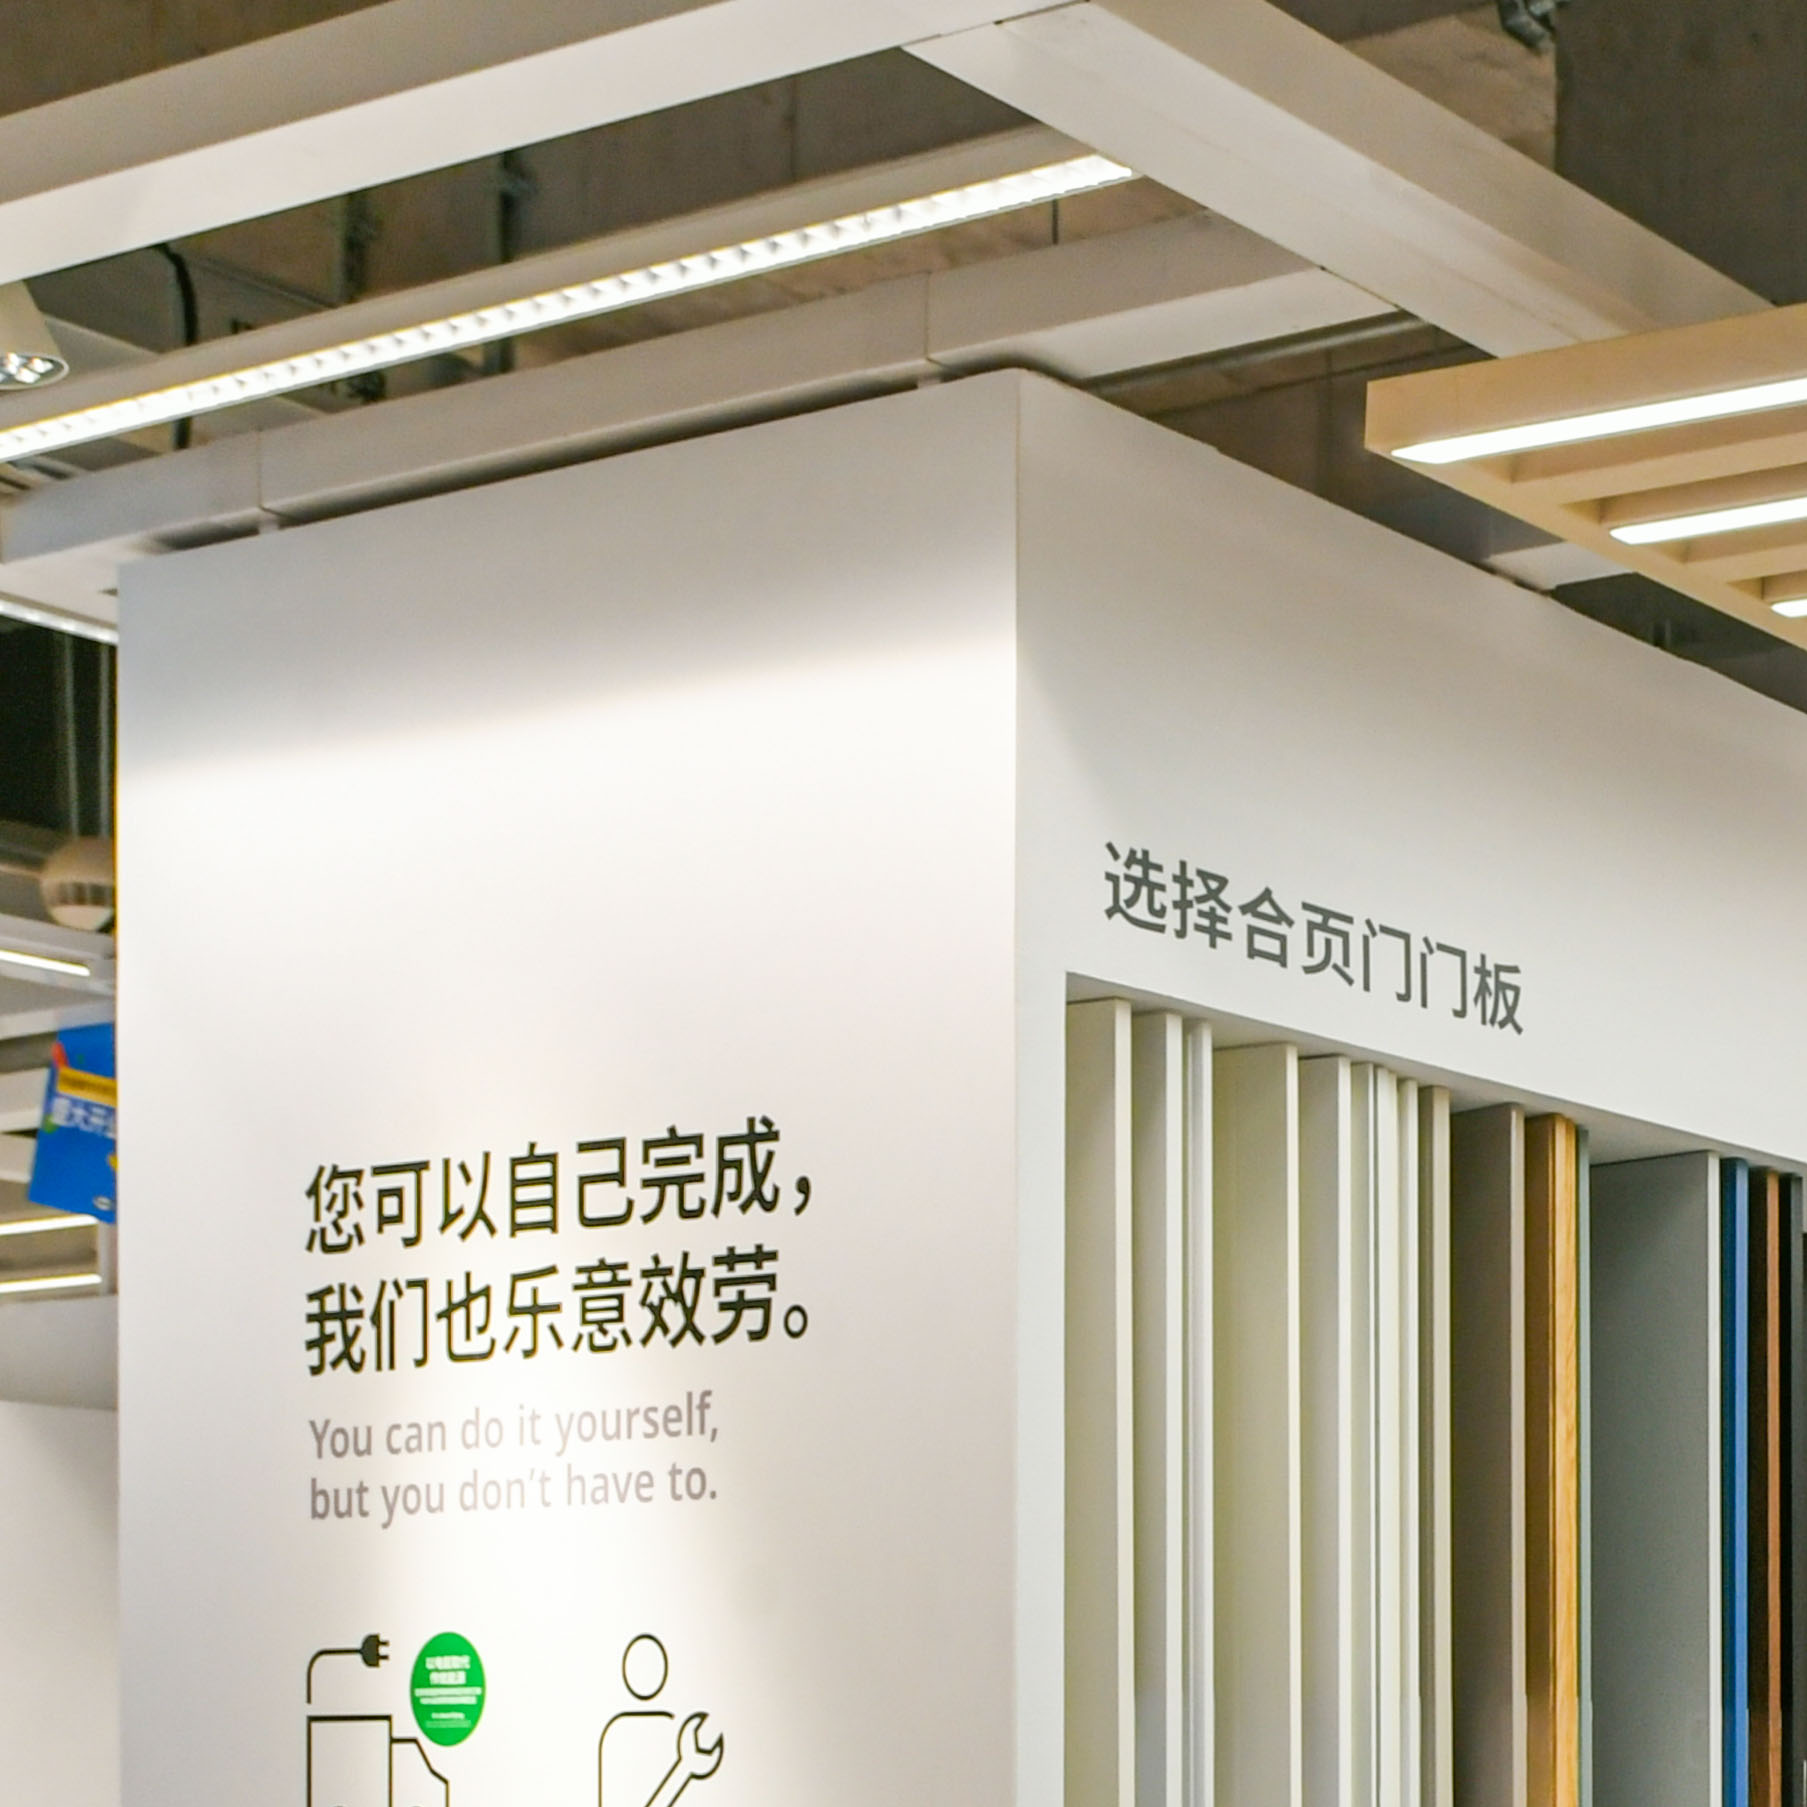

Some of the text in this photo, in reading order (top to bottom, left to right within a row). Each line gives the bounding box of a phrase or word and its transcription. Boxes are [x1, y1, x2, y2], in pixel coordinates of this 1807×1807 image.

[1104, 841, 1524, 1035] 选择合页门门板
[305, 1116, 811, 1254] 您可以自己完成，
[305, 1244, 808, 1376] 我们也乐意效劳。
[310, 1390, 719, 1459] You can do it yourself,
[310, 1461, 717, 1529] but you don't have to.
